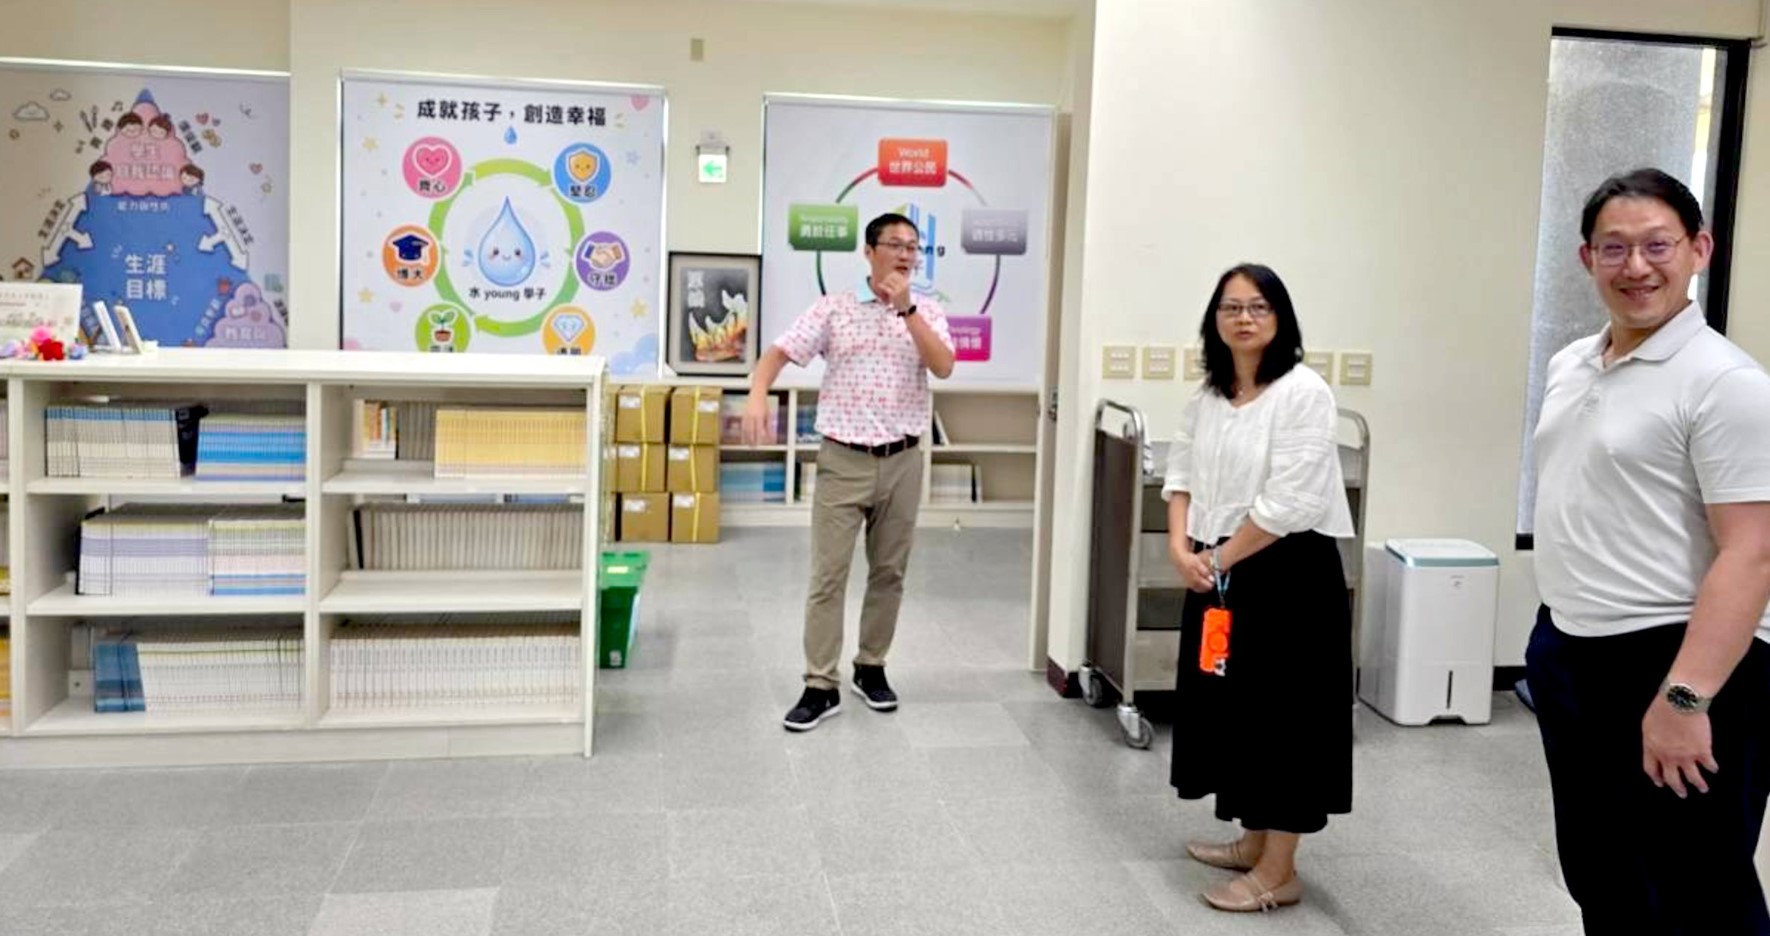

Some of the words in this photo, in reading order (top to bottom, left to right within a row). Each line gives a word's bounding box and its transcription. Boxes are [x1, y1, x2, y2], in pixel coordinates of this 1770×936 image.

[417, 99, 606, 126] 成就孩子，創造幸福
[889, 160, 937, 175] 世界公民
[125, 254, 167, 275] 生涯
[125, 279, 167, 300] 目標
[468, 286, 481, 299] 水
[484, 289, 520, 302] young
